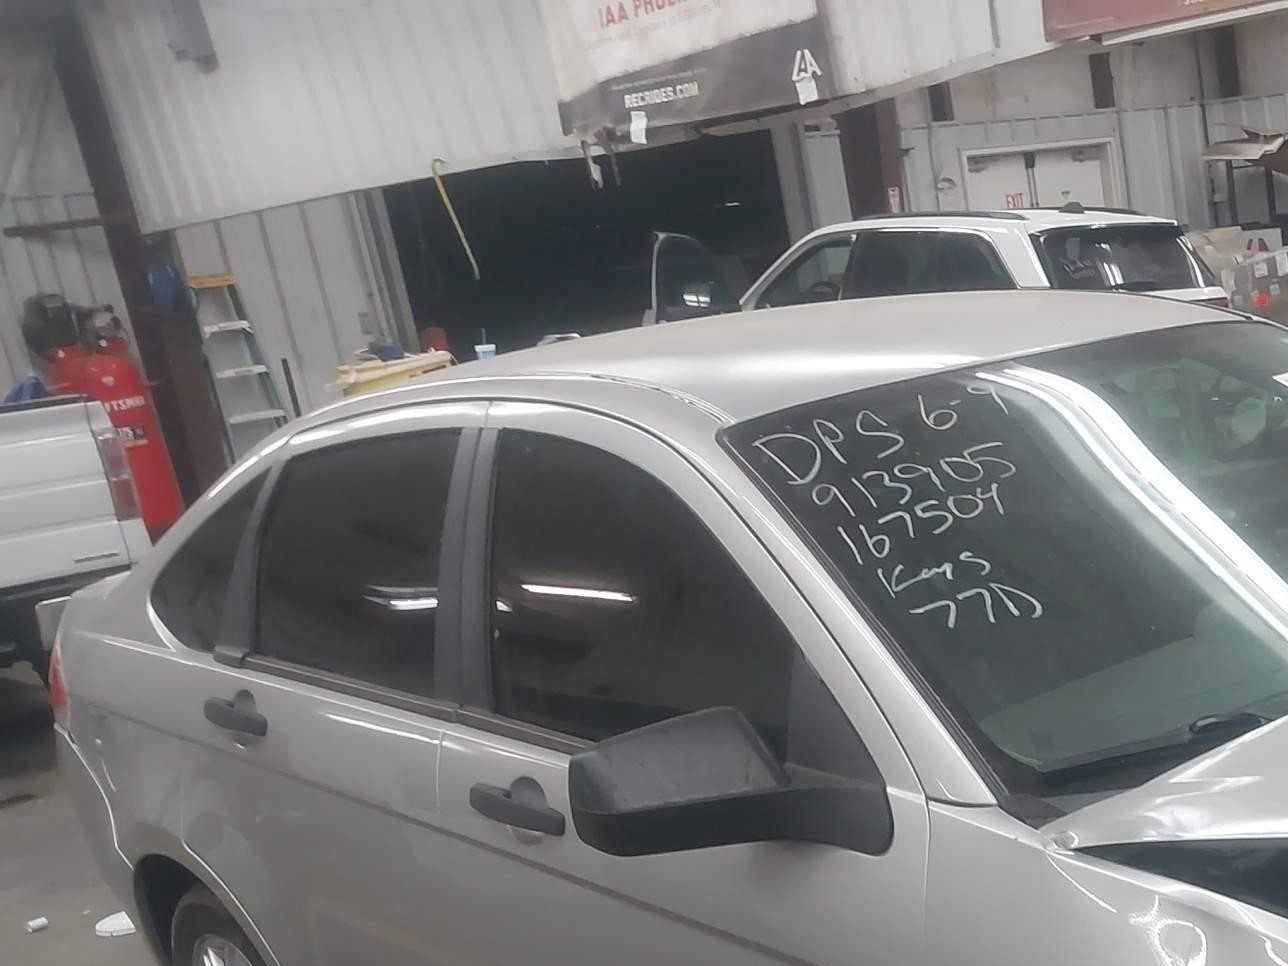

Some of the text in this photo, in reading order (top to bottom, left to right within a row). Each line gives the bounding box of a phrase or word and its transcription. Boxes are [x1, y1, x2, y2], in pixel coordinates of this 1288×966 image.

[752, 384, 1009, 485] DPS 6-9
[811, 441, 1017, 518] 913905
[836, 482, 1005, 566] 167504
